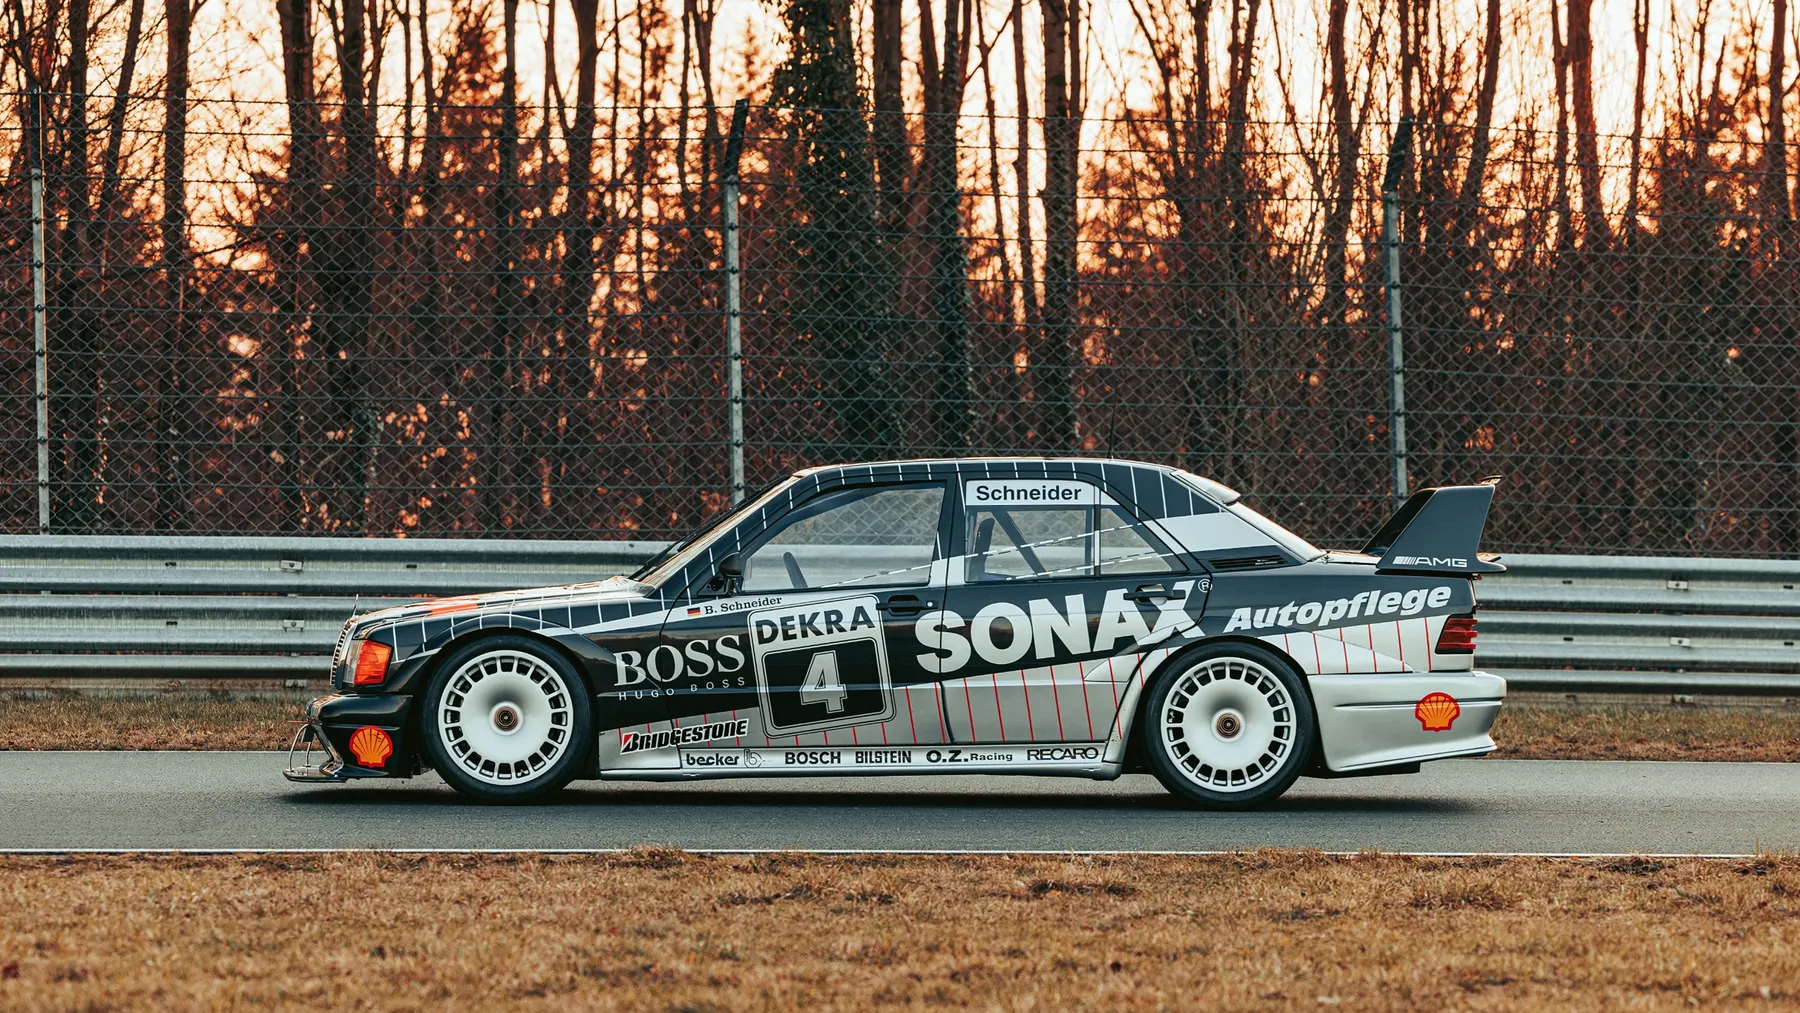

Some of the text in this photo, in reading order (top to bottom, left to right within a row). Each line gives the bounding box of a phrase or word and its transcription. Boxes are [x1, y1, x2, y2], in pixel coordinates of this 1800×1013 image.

[975, 485, 1082, 503] Schneider
[1415, 557, 1468, 567] AMG
[704, 596, 782, 615] B. Schneider
[1223, 586, 1452, 634] Autopflege
[755, 605, 875, 645] DEKRA
[613, 634, 746, 687] BOSS
[618, 676, 745, 701] HUGO BOSS
[799, 649, 848, 715] 4
[621, 719, 748, 753] BRIDGESTONE
[686, 753, 740, 766] becker
[784, 751, 841, 765] BOSCH
[855, 750, 912, 764] BILSTEIN
[926, 750, 1013, 763] O.Z. Racing
[1027, 748, 1099, 761] RECARO
